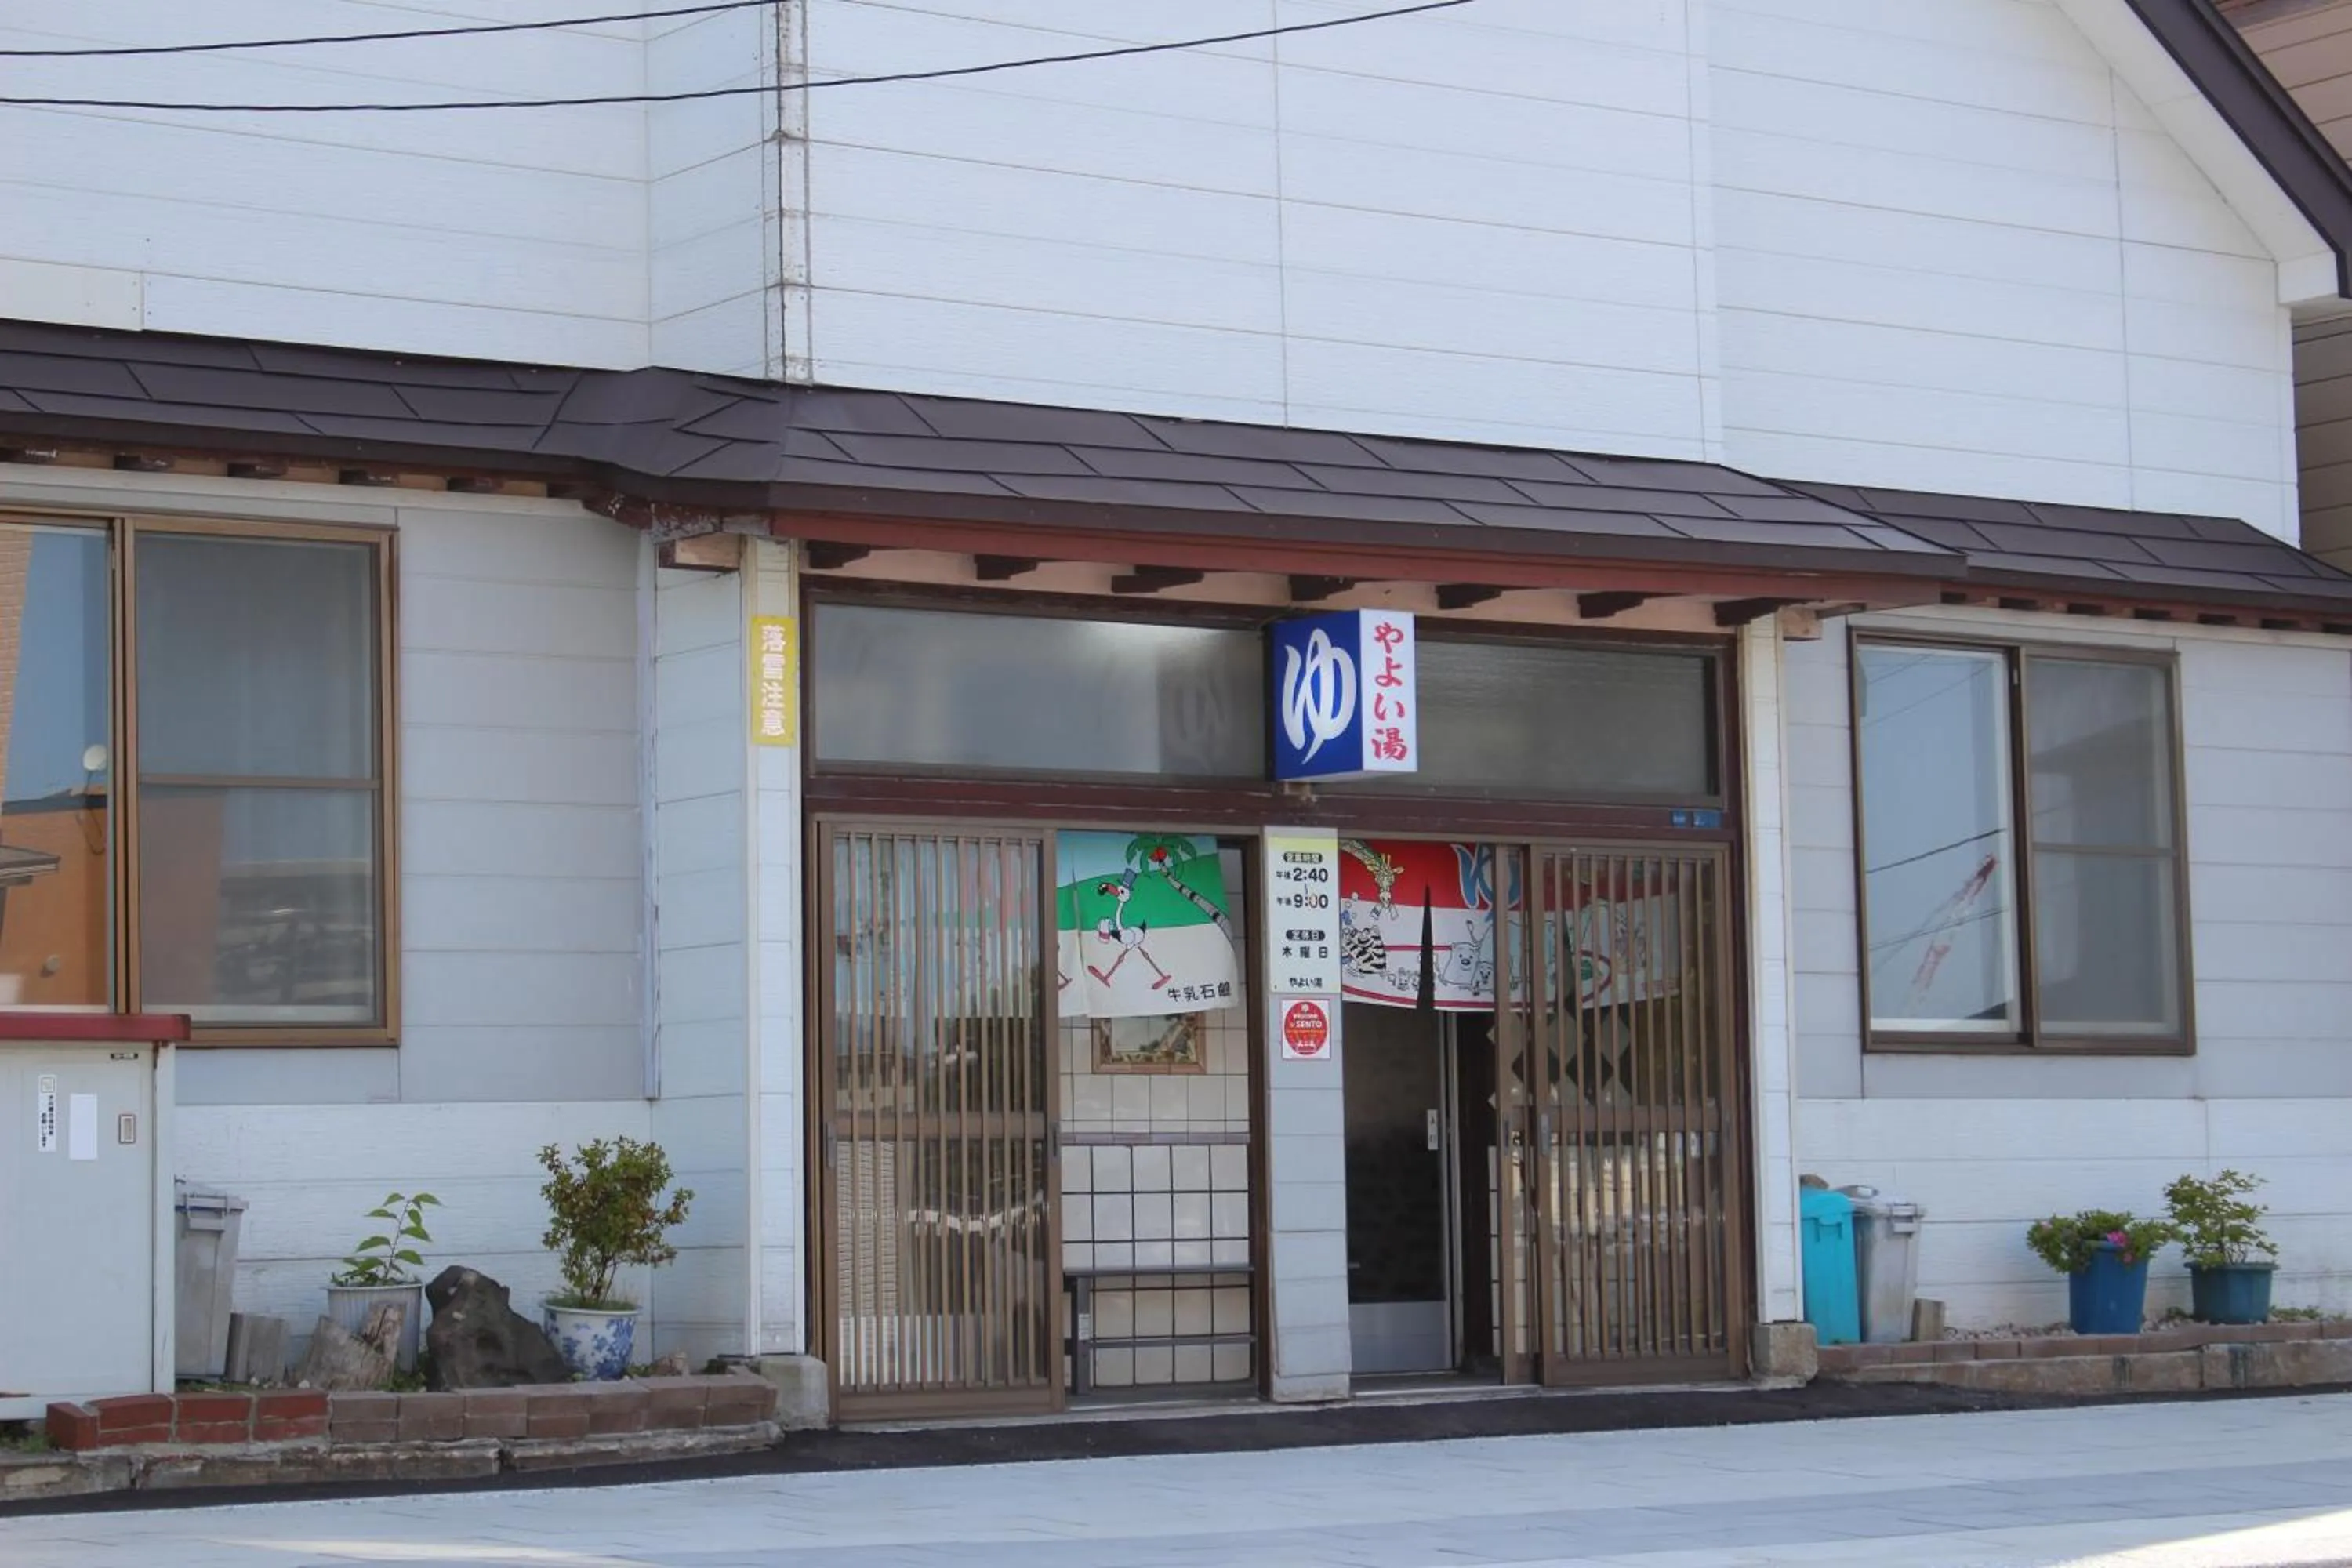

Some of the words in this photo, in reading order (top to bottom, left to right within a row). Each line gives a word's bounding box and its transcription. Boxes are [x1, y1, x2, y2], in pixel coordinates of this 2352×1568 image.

[1282, 628, 1357, 765] ゆ
[1371, 622, 1408, 761] やよい湯
